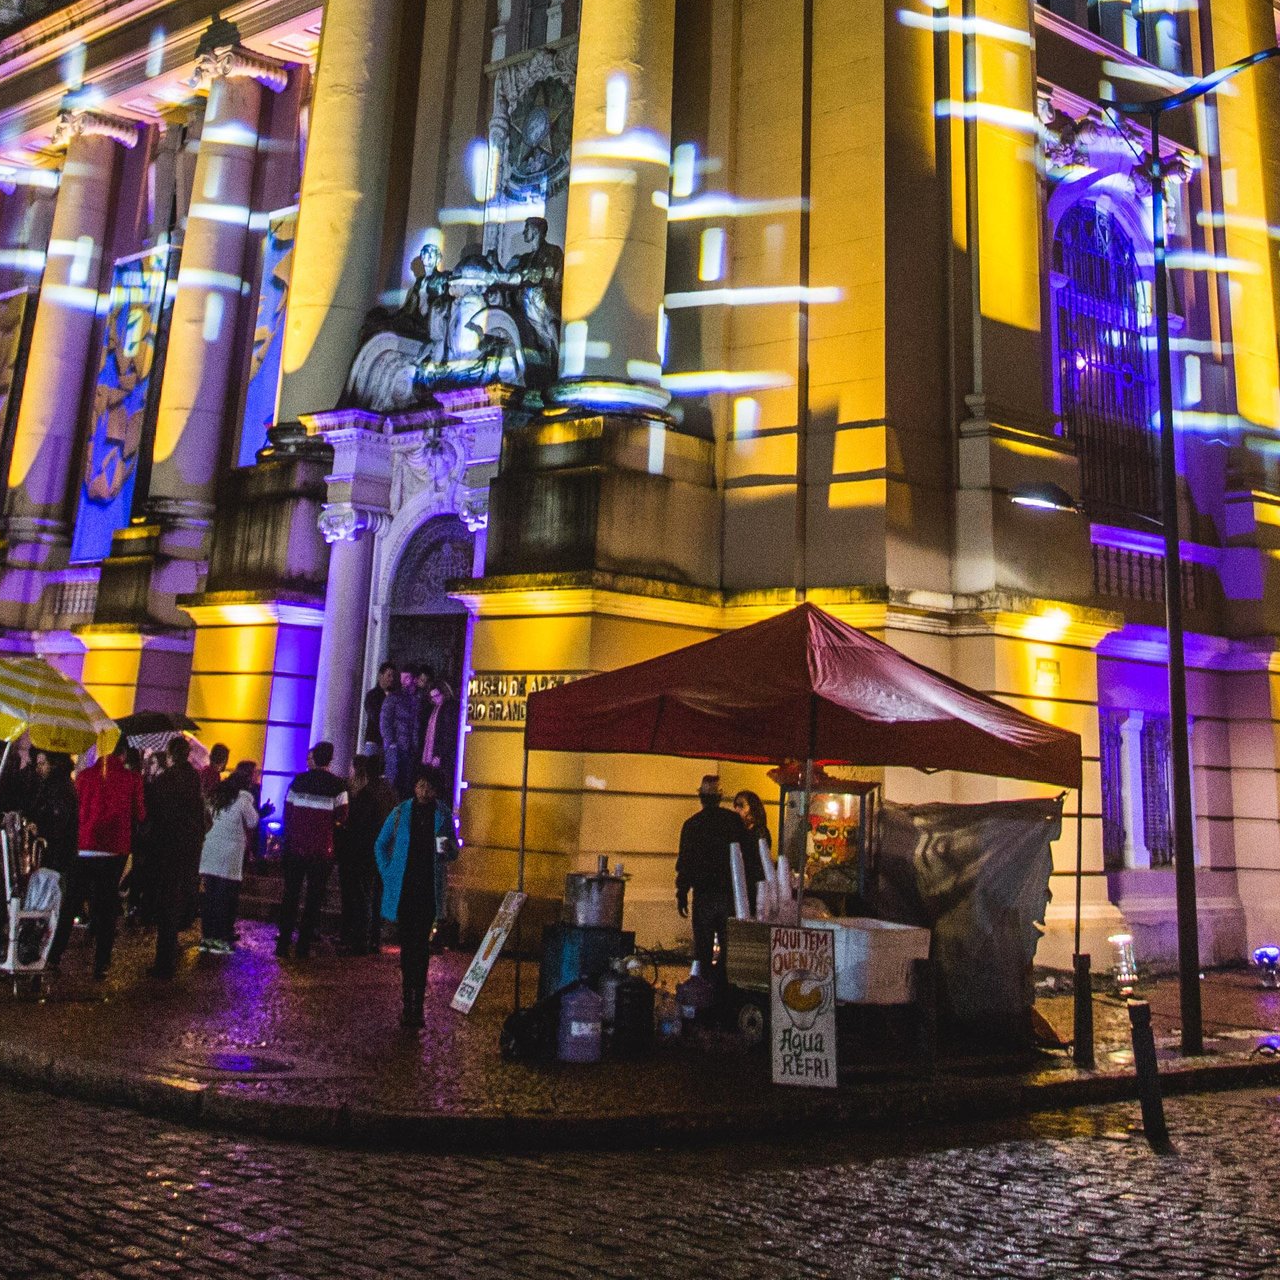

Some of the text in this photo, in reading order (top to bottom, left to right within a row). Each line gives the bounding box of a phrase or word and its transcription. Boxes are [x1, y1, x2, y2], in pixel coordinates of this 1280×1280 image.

[468, 677, 507, 697] MUSEU
[488, 699, 527, 721] GRAND
[773, 929, 828, 951] AQUI TEM
[781, 1054, 830, 1078] REFRI
